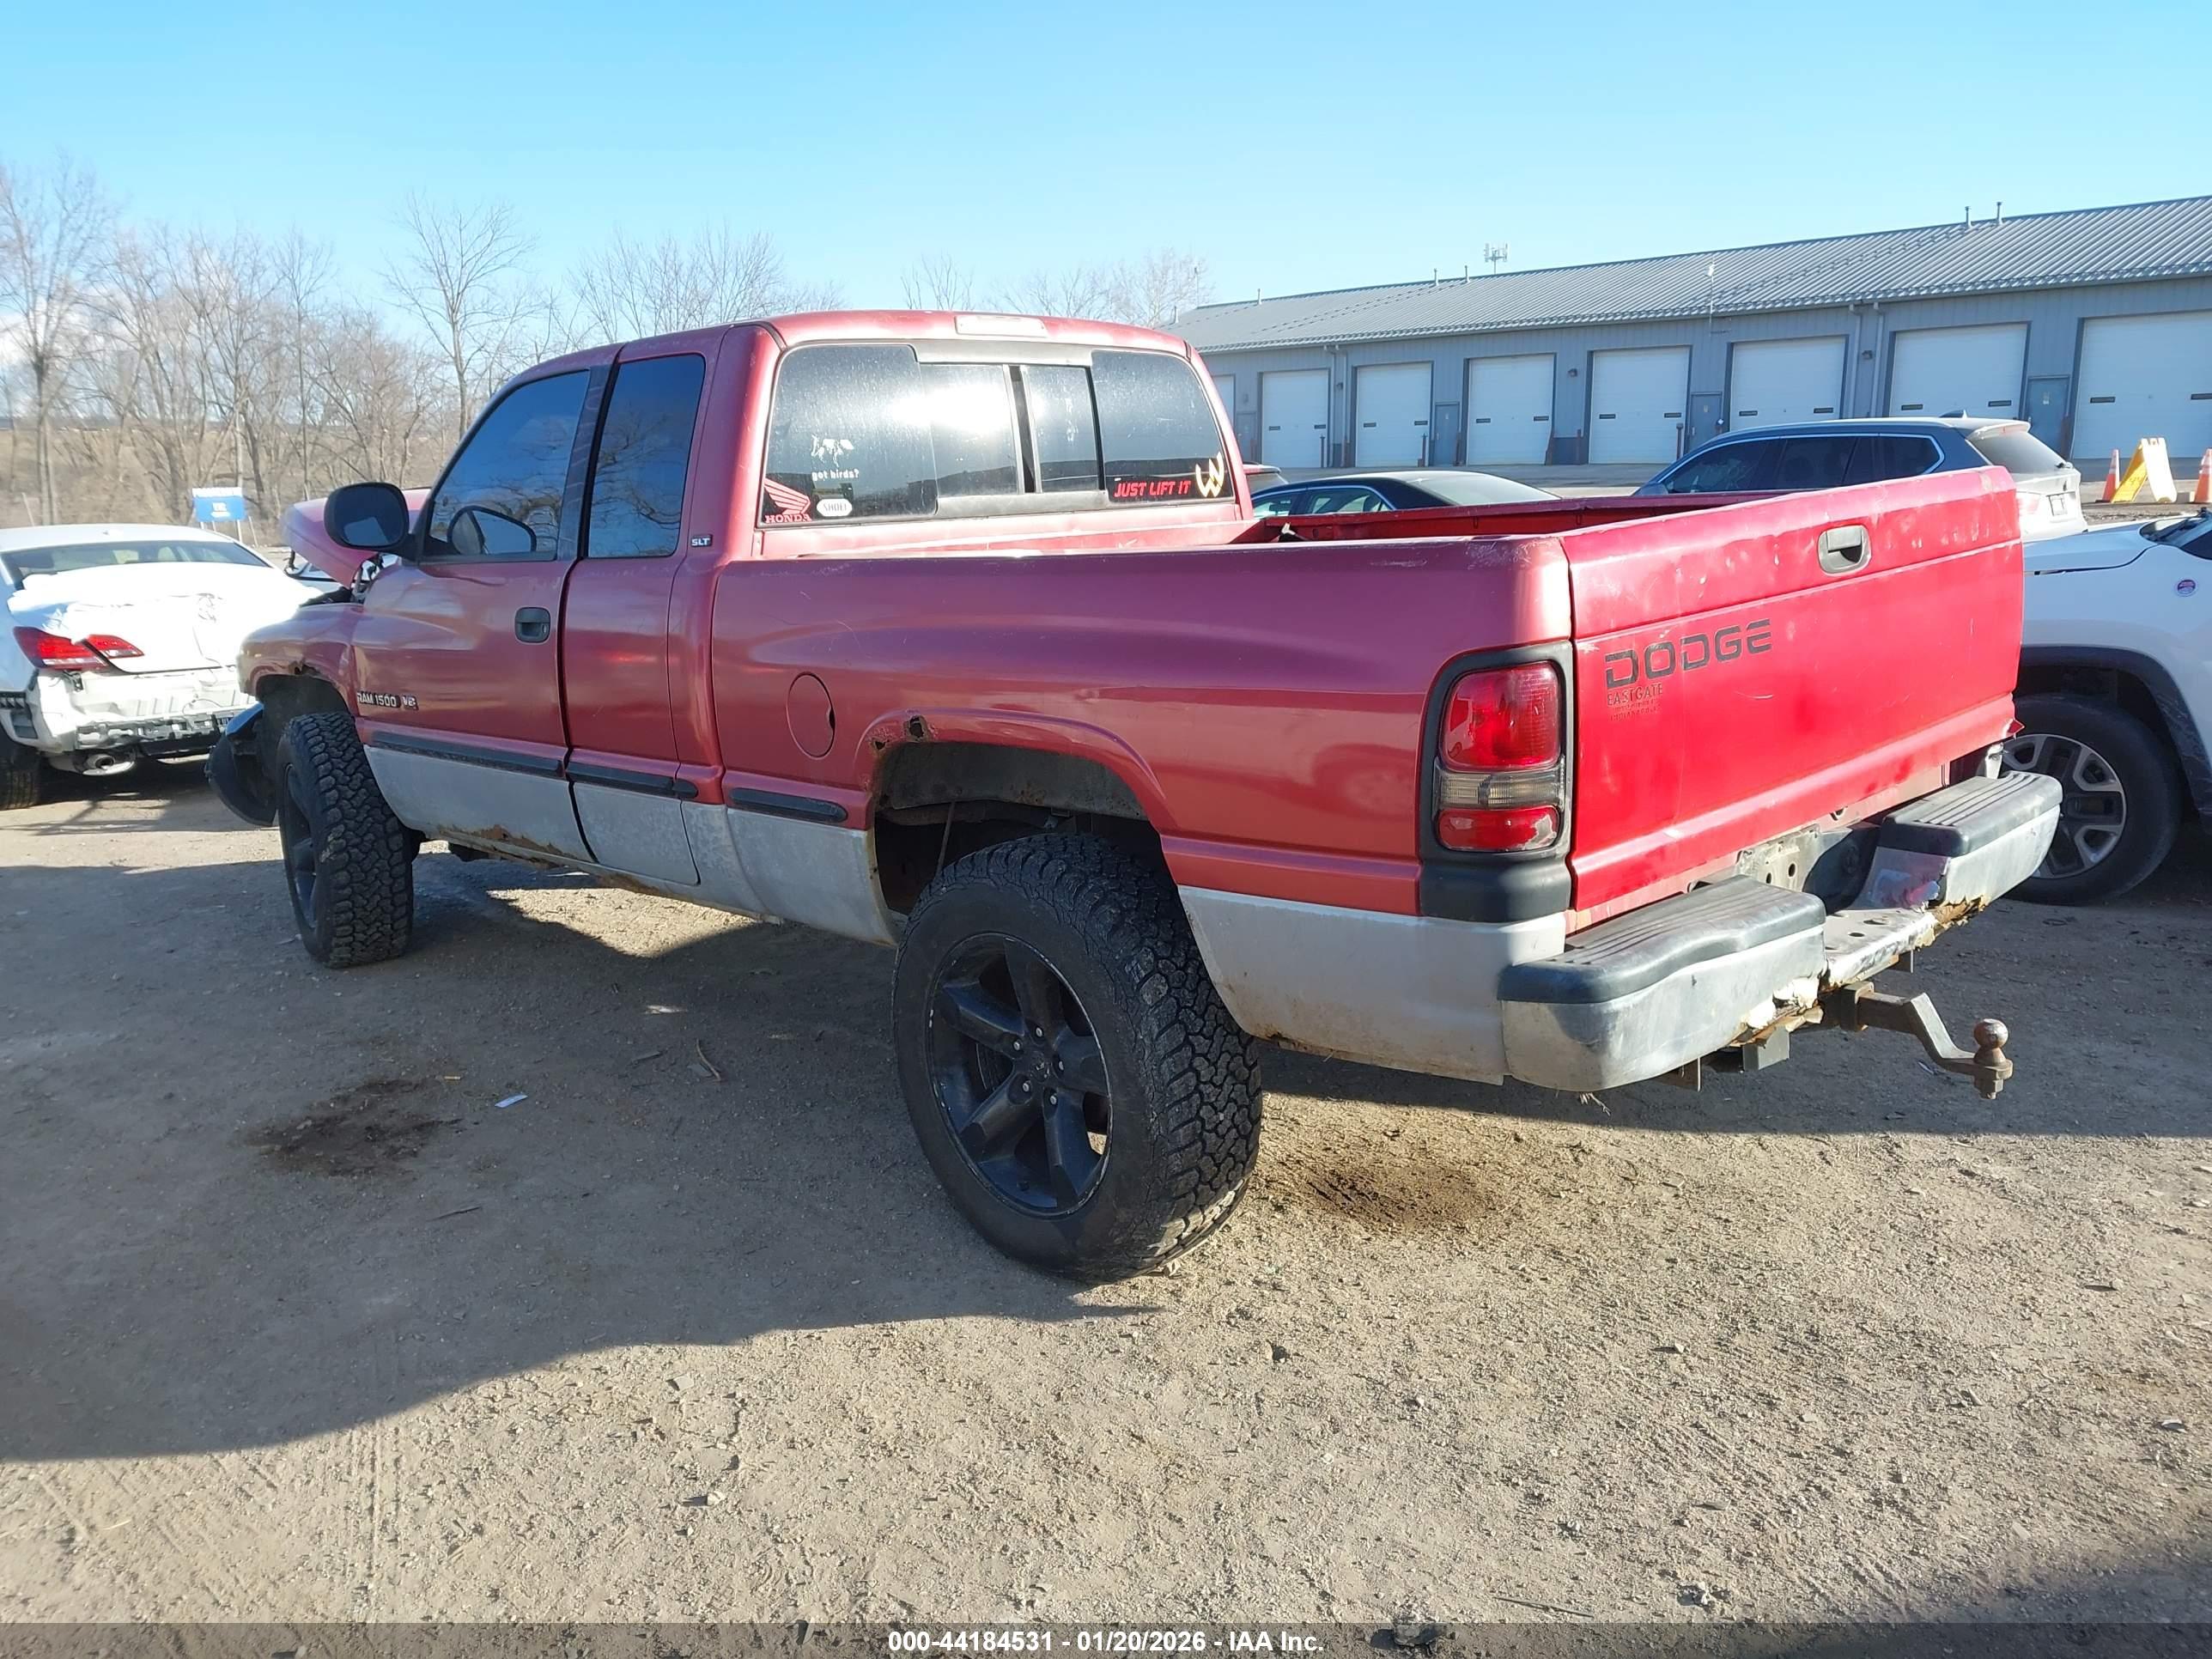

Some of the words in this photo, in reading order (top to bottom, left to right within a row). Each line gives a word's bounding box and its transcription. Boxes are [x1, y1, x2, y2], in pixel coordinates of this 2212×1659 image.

[811, 470, 828, 481] got
[1114, 483, 1147, 497] JUST
[1149, 481, 1176, 495] LIFT
[1178, 480, 1192, 495] IT
[764, 514, 812, 523] HONDA
[691, 538, 711, 546] SLT
[1605, 618, 1773, 690] DODGE
[356, 692, 374, 704] RAM
[374, 694, 398, 708] 1500
[1607, 683, 1663, 707] EASTGATE
